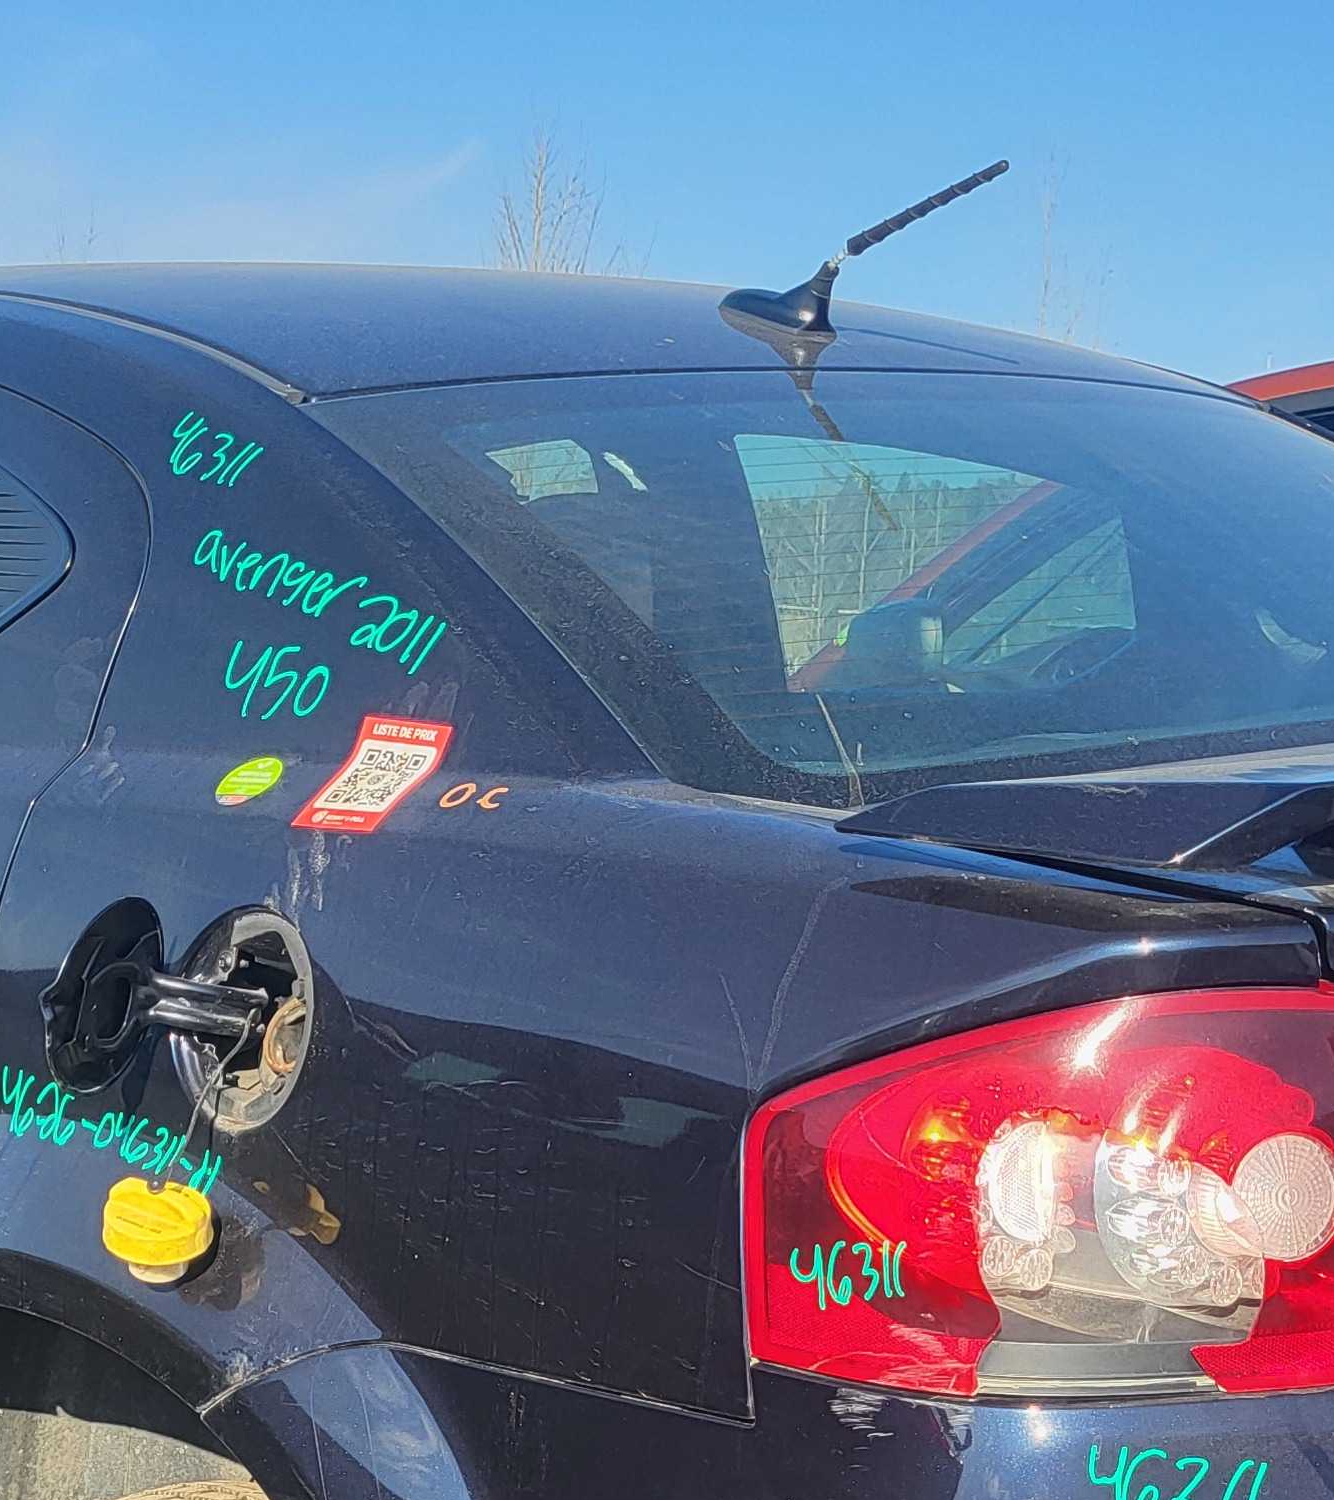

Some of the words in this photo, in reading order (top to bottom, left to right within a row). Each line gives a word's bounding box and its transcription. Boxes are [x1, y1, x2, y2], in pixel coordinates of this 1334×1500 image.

[170, 411, 263, 488] 46311
[194, 529, 367, 617] avenger
[350, 595, 447, 675] 2011
[224, 639, 331, 721] 450
[372, 723, 400, 738] LISTE
[398, 726, 414, 739] DE
[412, 728, 438, 742] PRIX
[789, 1239, 906, 1310] 46311
